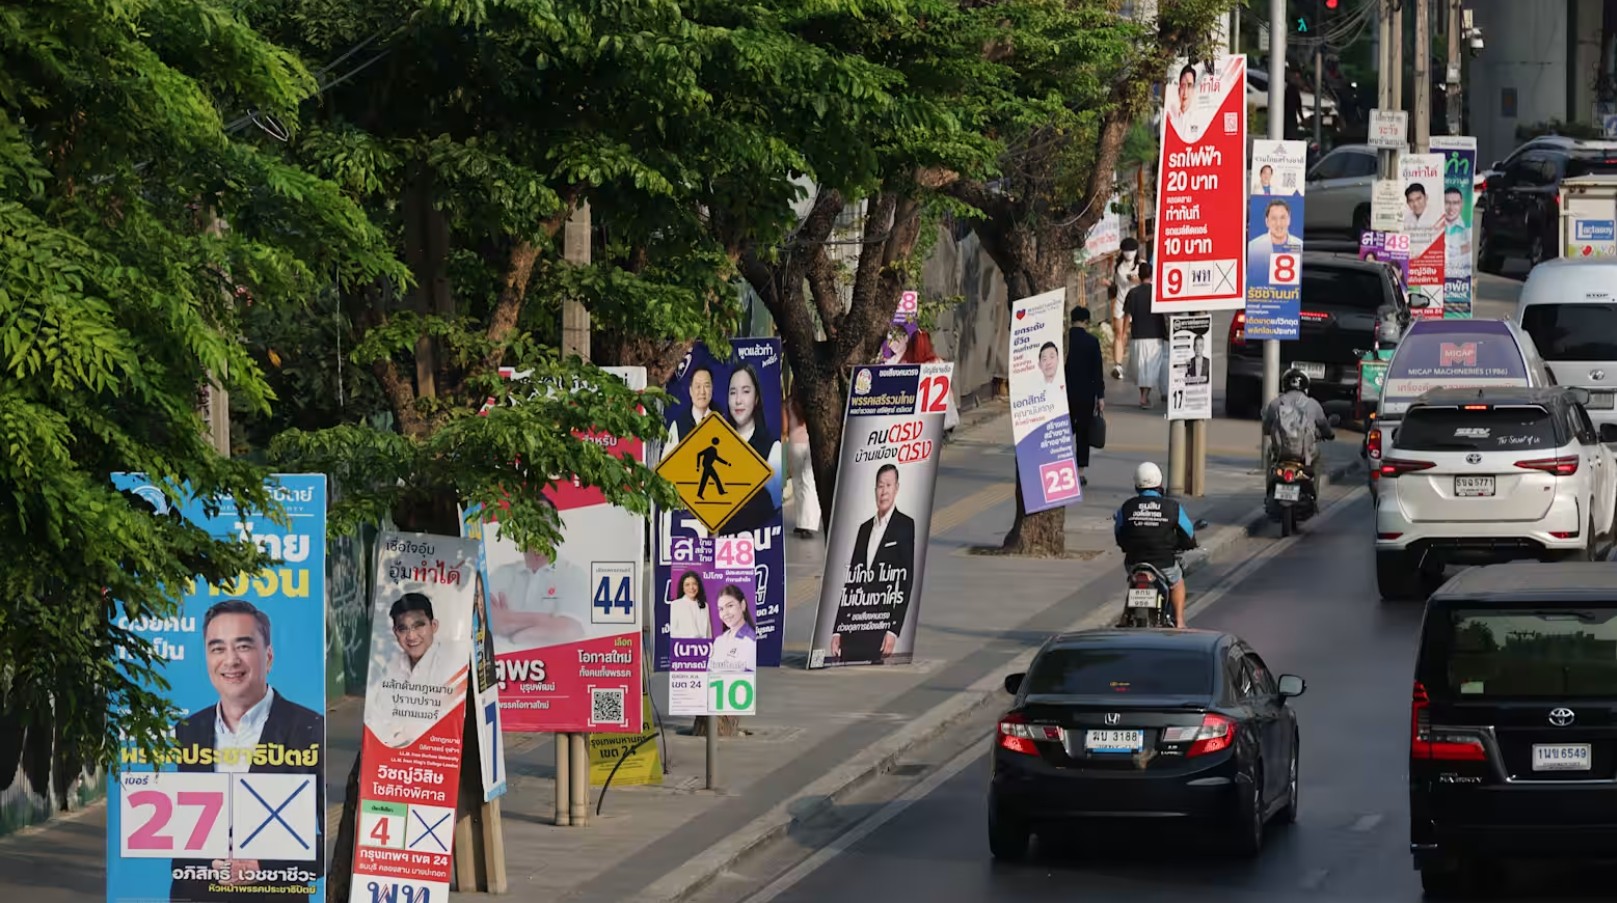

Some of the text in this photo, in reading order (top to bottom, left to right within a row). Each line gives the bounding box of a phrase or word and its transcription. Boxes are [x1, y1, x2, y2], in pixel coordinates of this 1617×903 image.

[1168, 145, 1222, 168] รถไฟฟ้า
[1166, 170, 1218, 192] 20 บาท
[1165, 204, 1200, 222] ทำทันที
[1577, 221, 1613, 238] Lactasoy
[1164, 237, 1212, 255] 10 บาท
[1385, 235, 1409, 249] 48
[1273, 254, 1296, 283] 8
[1167, 268, 1183, 295] 9
[900, 292, 916, 311] 8
[1014, 321, 1045, 336] ยกระดับ
[738, 343, 773, 359] พูดแล้วทำ
[1444, 349, 1475, 357] MICAP
[1433, 367, 1484, 375] MACHINERIES
[851, 390, 915, 406] พรรคเสรีรวมไทย
[918, 375, 950, 413] 12
[1173, 390, 1183, 409] 17
[867, 420, 924, 446] คนตรง
[855, 440, 932, 464] บ้านเมืองตรง
[1046, 467, 1075, 494] 23
[386, 538, 435, 559] เชื่อใจอุ้ม
[716, 540, 754, 566] 48
[389, 560, 466, 586] อุ้มทำได้
[845, 563, 907, 583] ไม่โกง ไม่เทา
[184, 568, 310, 598] ายจน
[593, 575, 634, 615] 44
[840, 586, 904, 609] ไม่เป็นเงาใคร
[756, 604, 780, 617] ขต 24
[118, 615, 196, 633] ดวยคน
[577, 649, 633, 664] โอกาสใหม่
[674, 641, 713, 658] (นาง)
[382, 679, 454, 696] ผลักดันกฎหมาย
[672, 680, 702, 690] เขต 24
[392, 694, 442, 708] ปราบปราม
[709, 679, 754, 711] 10
[392, 706, 441, 720] สแกมเมอร์
[1113, 731, 1138, 742] 3188
[121, 742, 319, 767] พรรคประชาธิปัตย์
[600, 748, 619, 758] เขต
[1561, 747, 1587, 759] 6549
[124, 775, 150, 786] เบอร์
[372, 781, 446, 802] โชติกิจพิศาล
[127, 790, 225, 851] 27
[370, 817, 390, 846] 4
[360, 849, 449, 867] กรุงเทพฯ เขต 24
[172, 862, 317, 882] อภิสิทธิ์ เวชชาชีวะ
[208, 881, 317, 895] หัวหน้าพรรคประชาธิปัตย์
